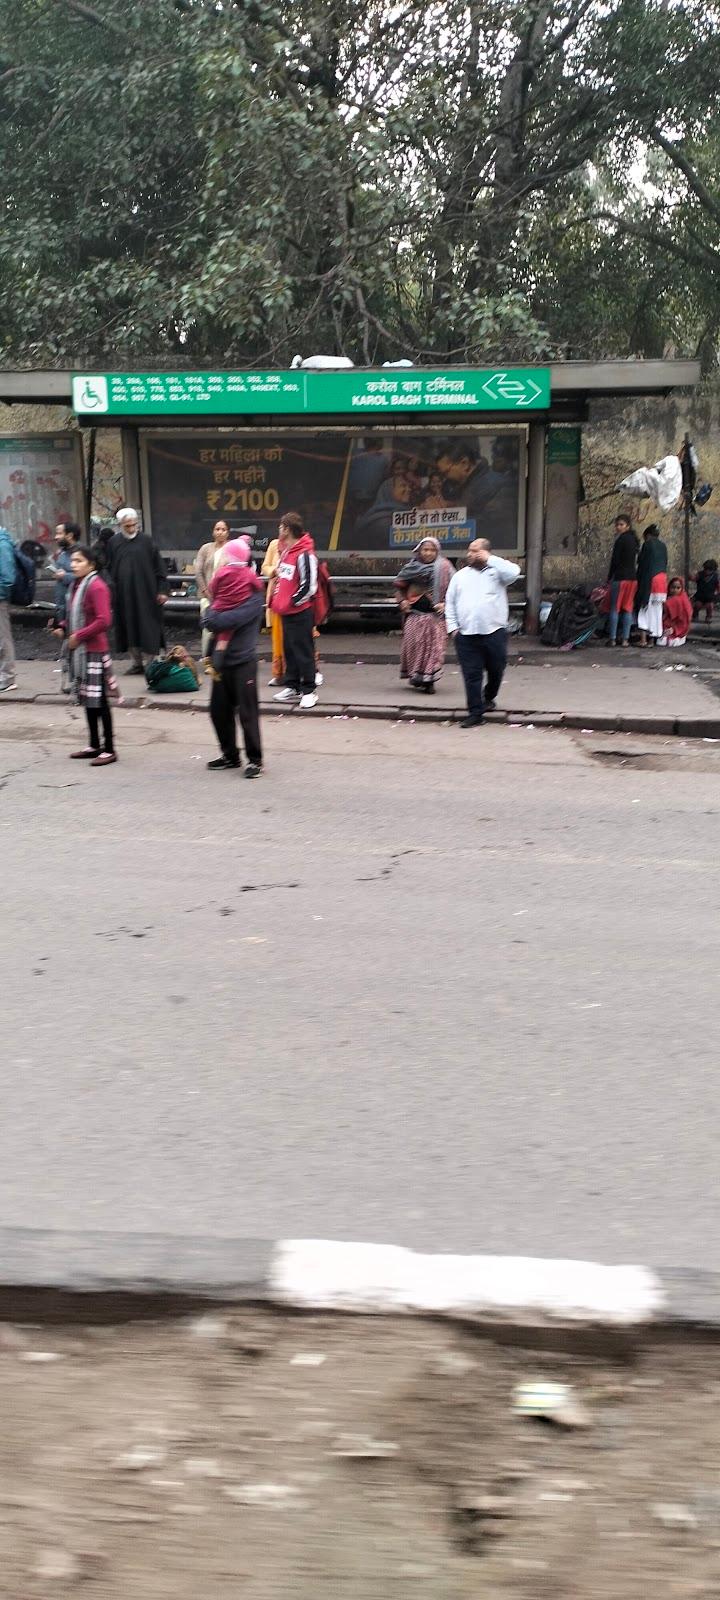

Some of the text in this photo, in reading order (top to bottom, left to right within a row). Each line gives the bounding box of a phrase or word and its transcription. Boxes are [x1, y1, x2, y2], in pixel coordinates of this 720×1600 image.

[365, 377, 466, 393] करोल बाग टर्मिनल
[351, 394, 479, 406] KAROL BAGH TERMINAL
[200, 444, 283, 463] हर महिला को
[213, 466, 266, 484] हर महीने
[394, 507, 417, 526] भाई
[419, 511, 428, 525] हो
[430, 510, 440, 524] तो
